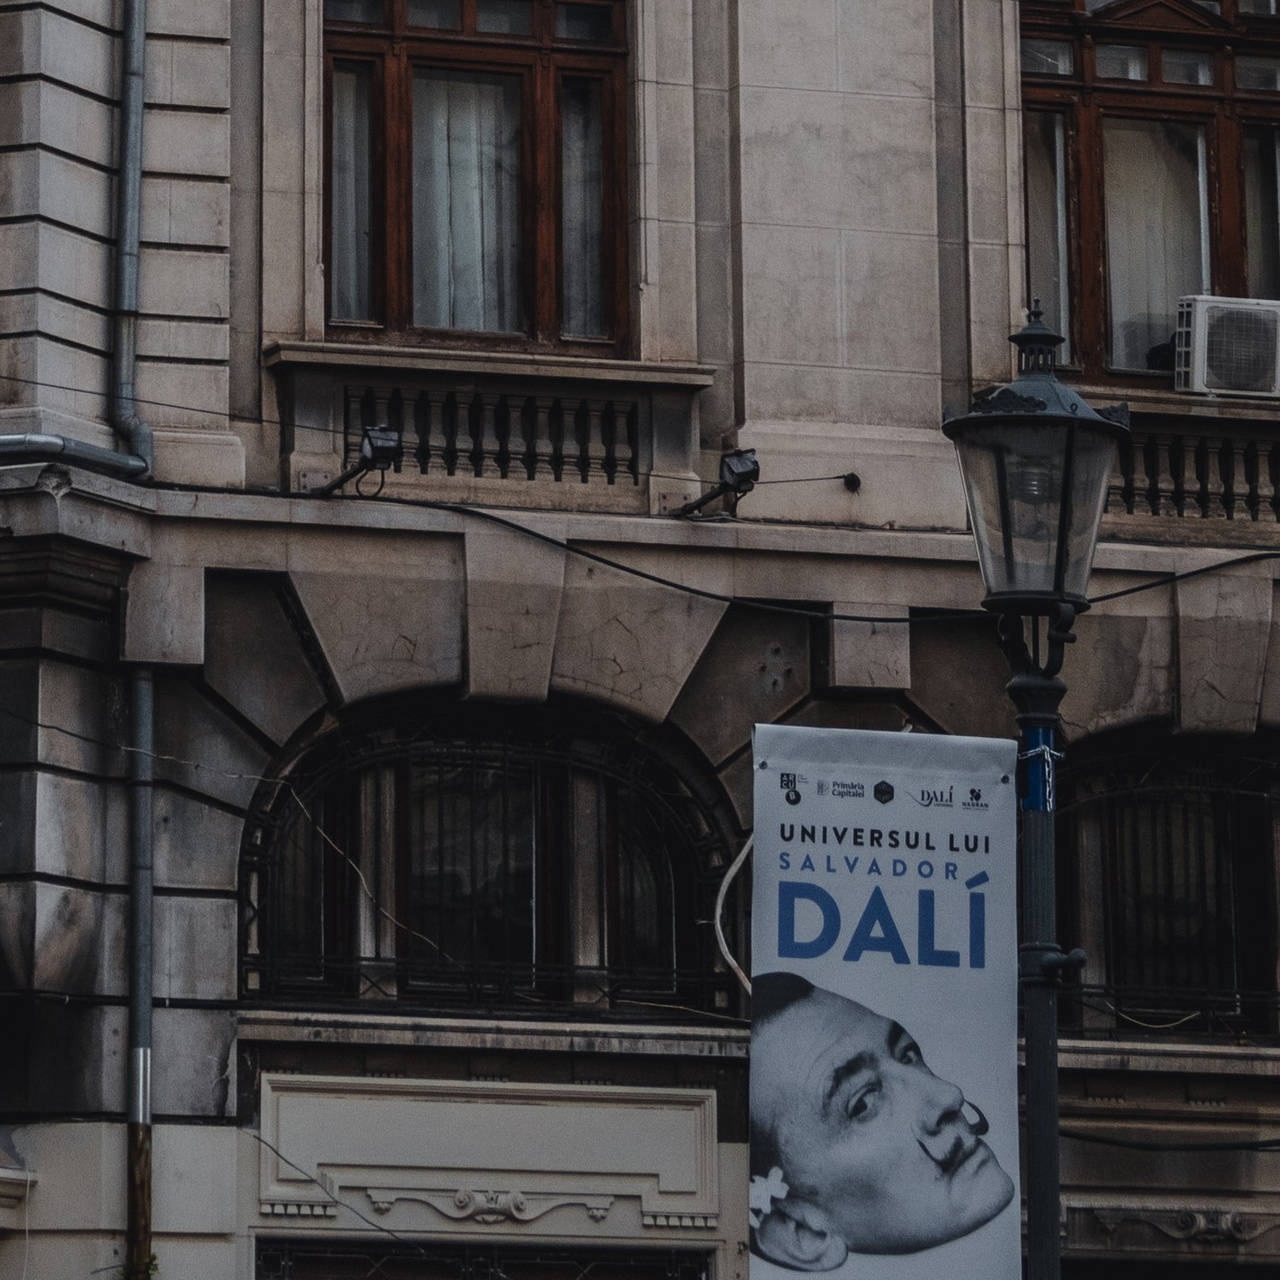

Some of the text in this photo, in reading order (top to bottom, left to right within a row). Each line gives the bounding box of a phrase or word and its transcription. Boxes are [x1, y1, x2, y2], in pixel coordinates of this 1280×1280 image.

[832, 789, 864, 798] Capitalei
[780, 823, 990, 854] UNIVERSUL LUI
[779, 852, 958, 880] SALVADOR
[777, 870, 990, 969] DALÍ
